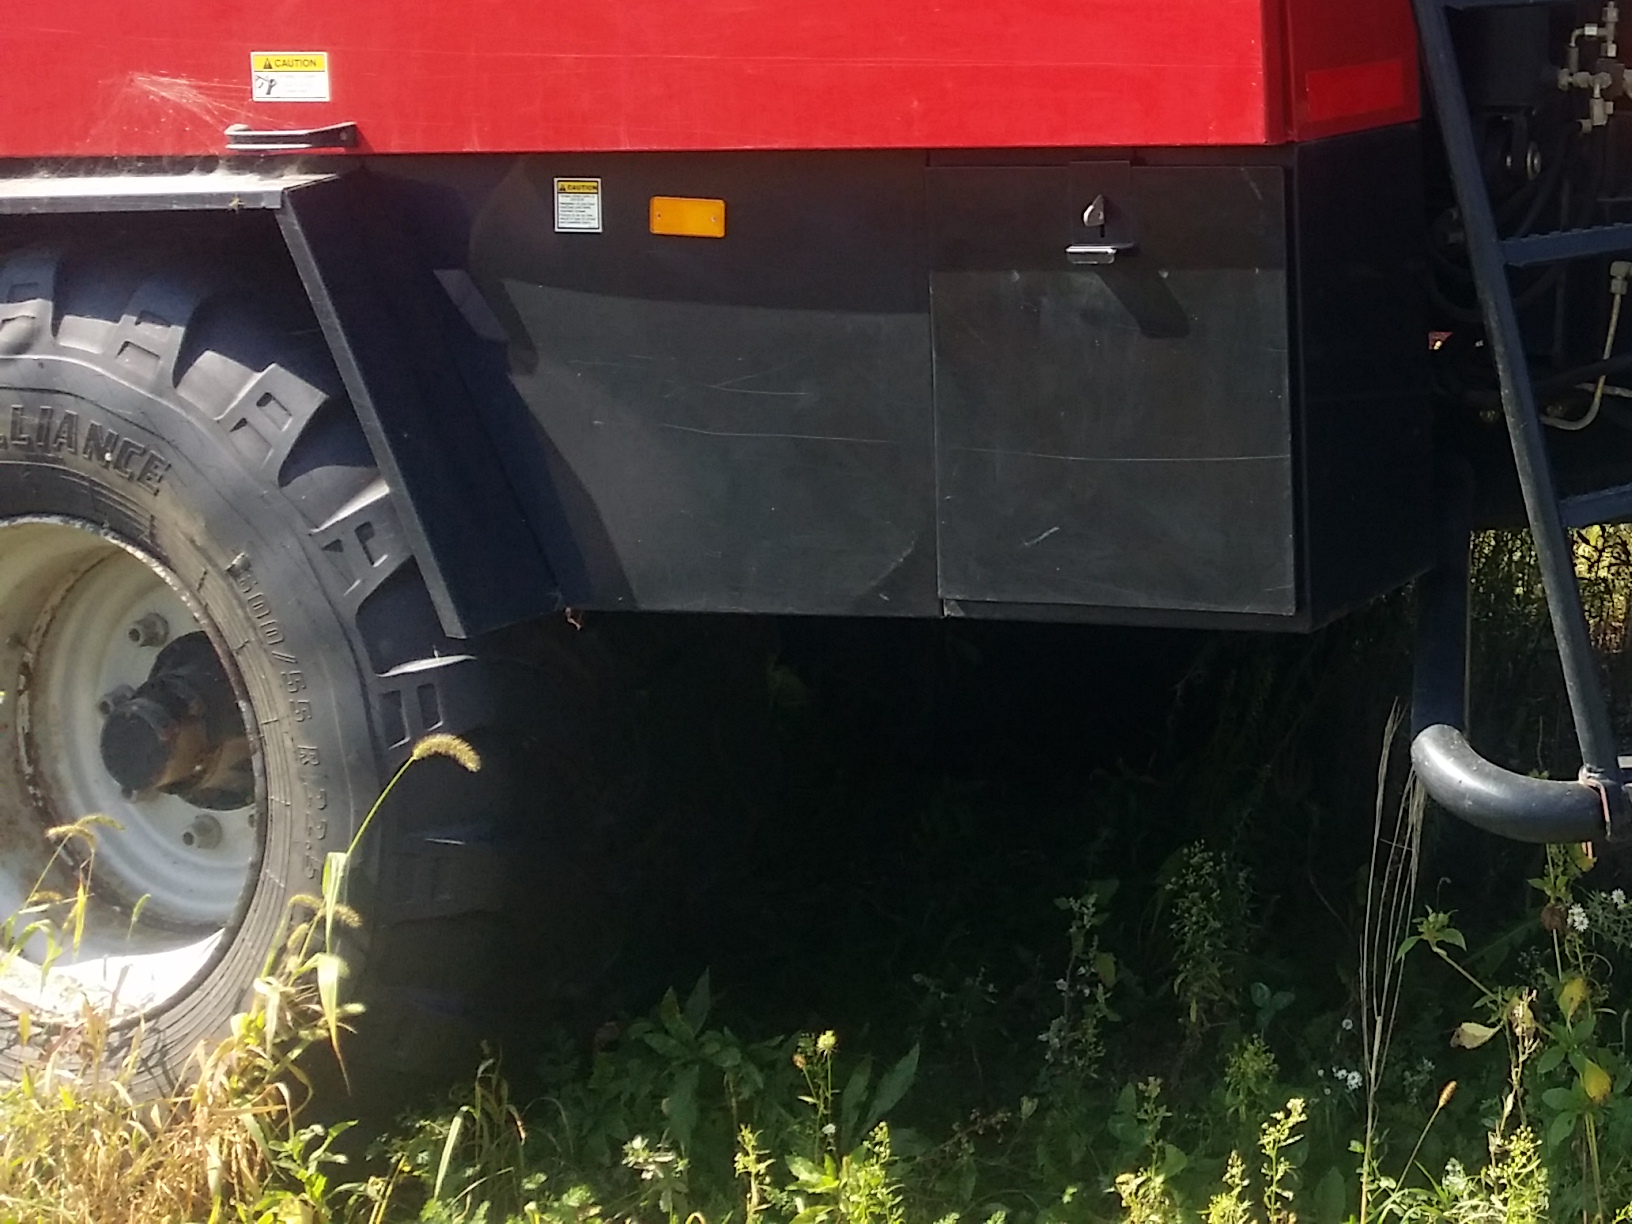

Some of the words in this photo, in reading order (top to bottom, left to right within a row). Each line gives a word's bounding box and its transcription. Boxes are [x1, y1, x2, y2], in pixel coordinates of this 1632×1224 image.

[274, 58, 317, 68] CAUTION
[0, 404, 172, 496] LIANCE
[297, 744, 321, 767] R
